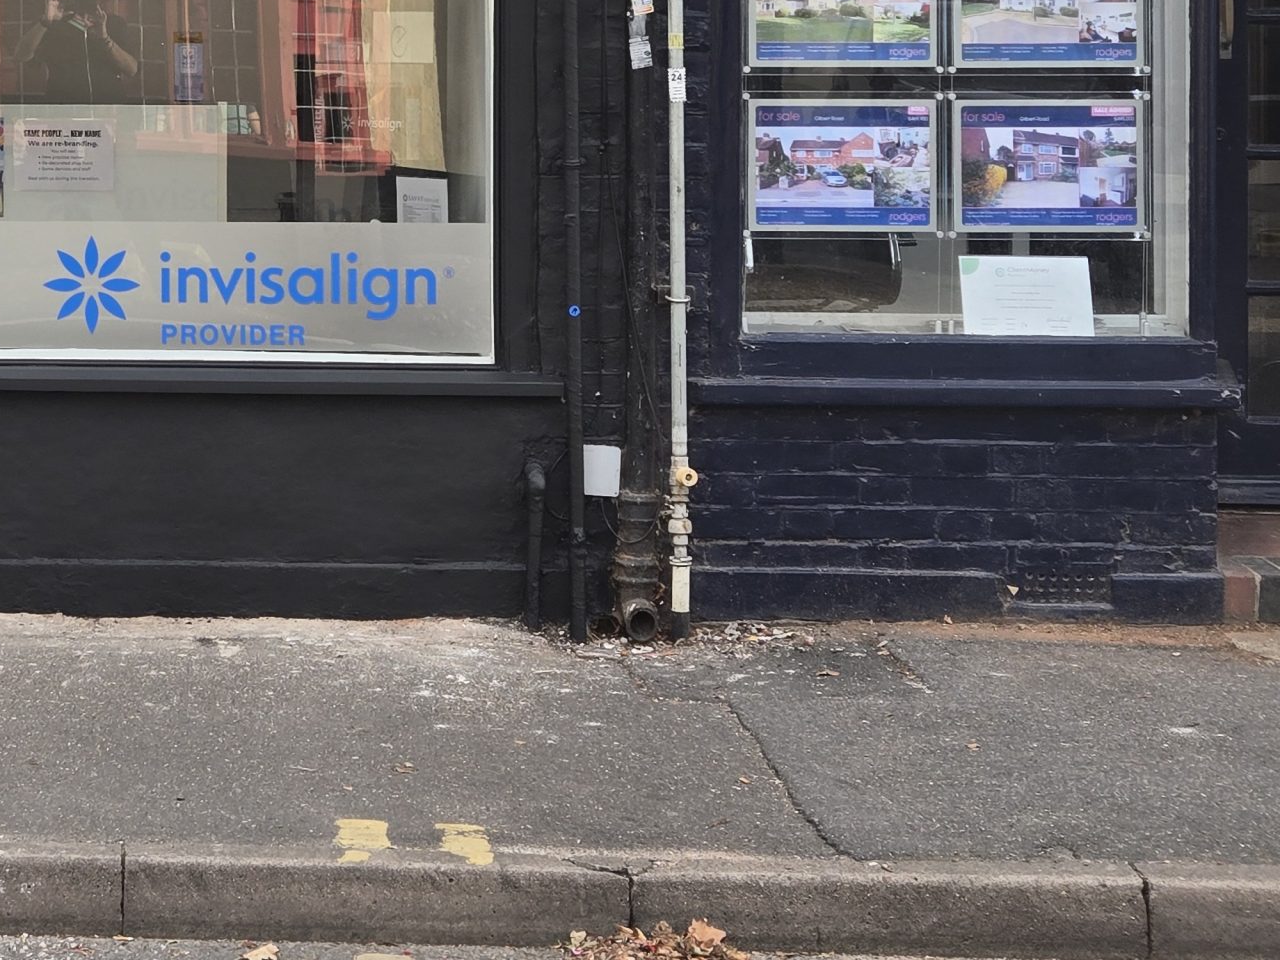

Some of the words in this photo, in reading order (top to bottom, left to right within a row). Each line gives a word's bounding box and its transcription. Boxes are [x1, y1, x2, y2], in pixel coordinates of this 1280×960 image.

[889, 47, 926, 58] rodgers
[1096, 48, 1132, 58] rodgers
[758, 111, 774, 121] for
[776, 111, 800, 121] sale
[962, 112, 979, 122] for
[980, 112, 1006, 122] sale
[889, 212, 926, 222] rodgers
[1096, 212, 1133, 222] rodgers
[161, 324, 306, 346] PROVIDER
